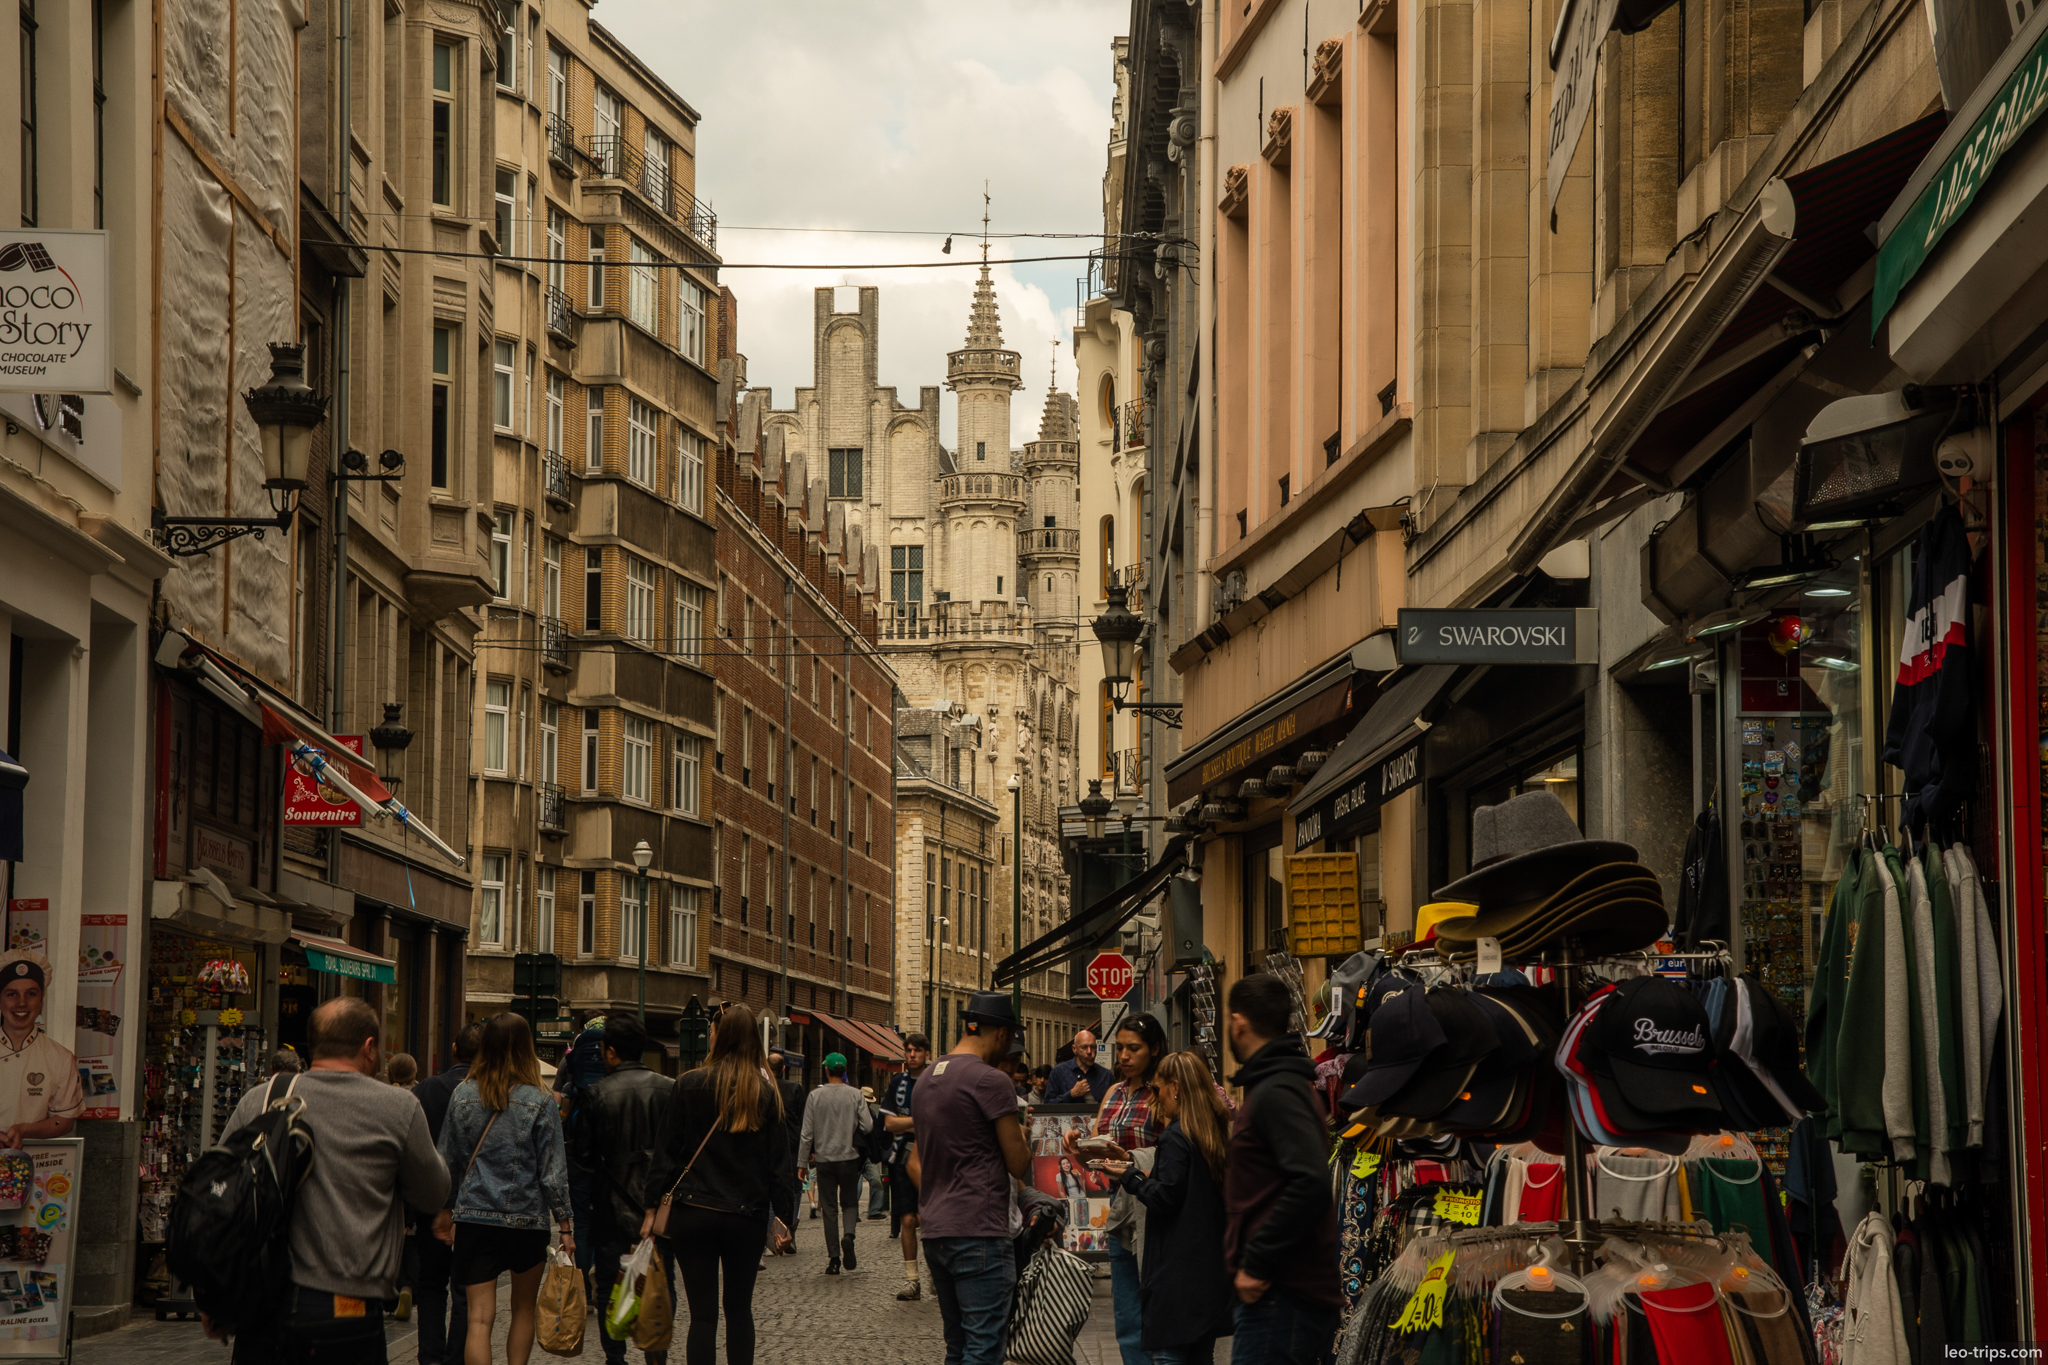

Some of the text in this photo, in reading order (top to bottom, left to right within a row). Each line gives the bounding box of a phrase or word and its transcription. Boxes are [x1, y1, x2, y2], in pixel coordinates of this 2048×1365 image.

[1924, 125, 1988, 248] LACE
[0, 310, 93, 358] Story
[1, 352, 67, 363] CHOCOLATE
[0, 365, 47, 375] MUSEUM
[1439, 626, 1566, 646] SWAROVSKI
[284, 806, 357, 821] Souvenirs
[1297, 810, 1321, 848] PANDORA
[1089, 968, 1131, 986] STOP
[228, 1012, 237, 1024] 5
[31, 1153, 49, 1161] FREE
[36, 1159, 64, 1168] INSIDE
[0, 1316, 49, 1326] RALINE BOXES
